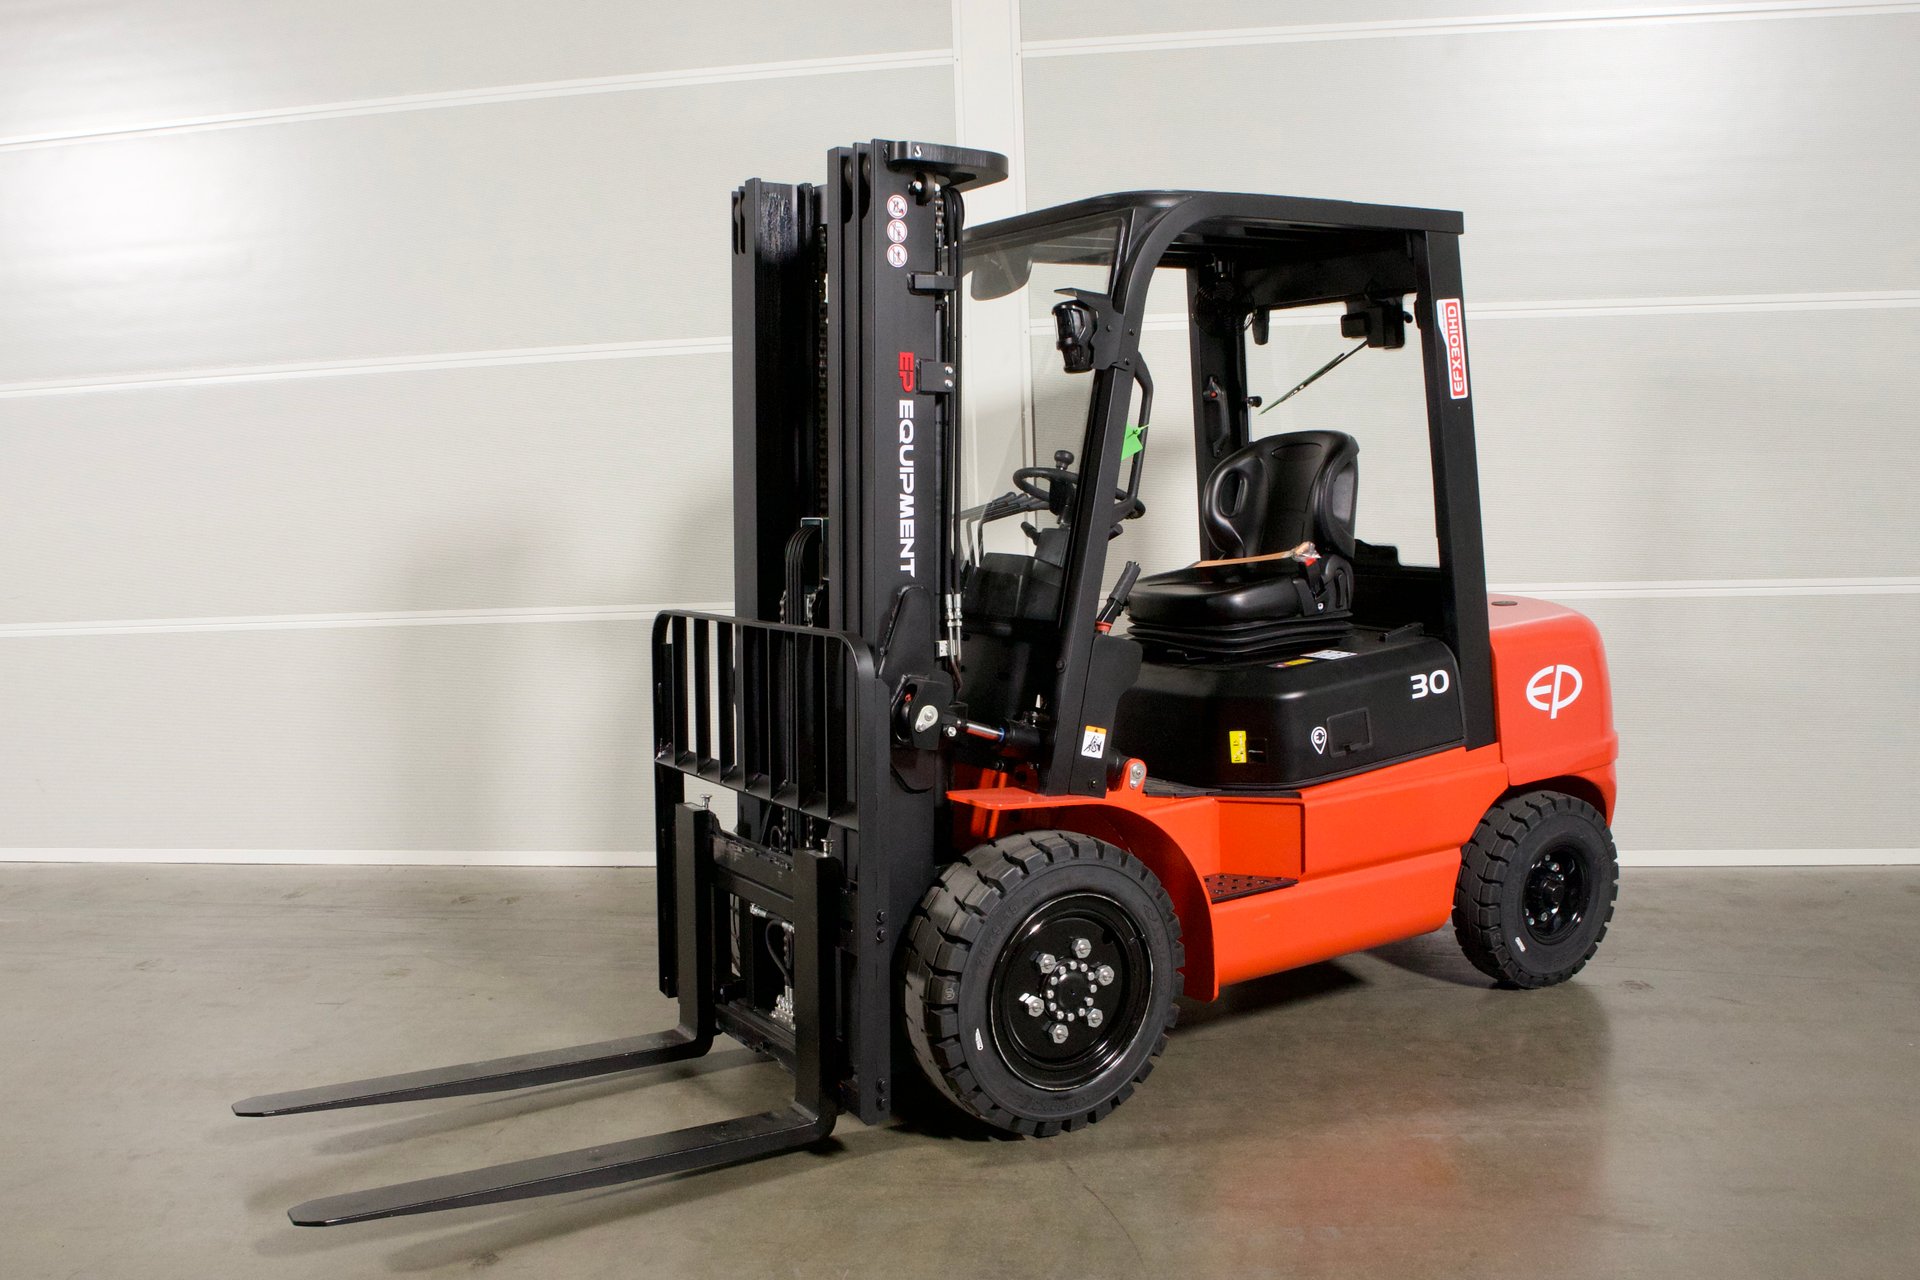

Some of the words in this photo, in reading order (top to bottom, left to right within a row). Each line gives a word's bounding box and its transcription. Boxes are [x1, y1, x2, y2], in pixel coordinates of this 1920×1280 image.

[898, 351, 915, 393] EP
[899, 399, 916, 578] EQUIPMENT
[1410, 669, 1450, 700] 30
[1526, 664, 1583, 720] EP
